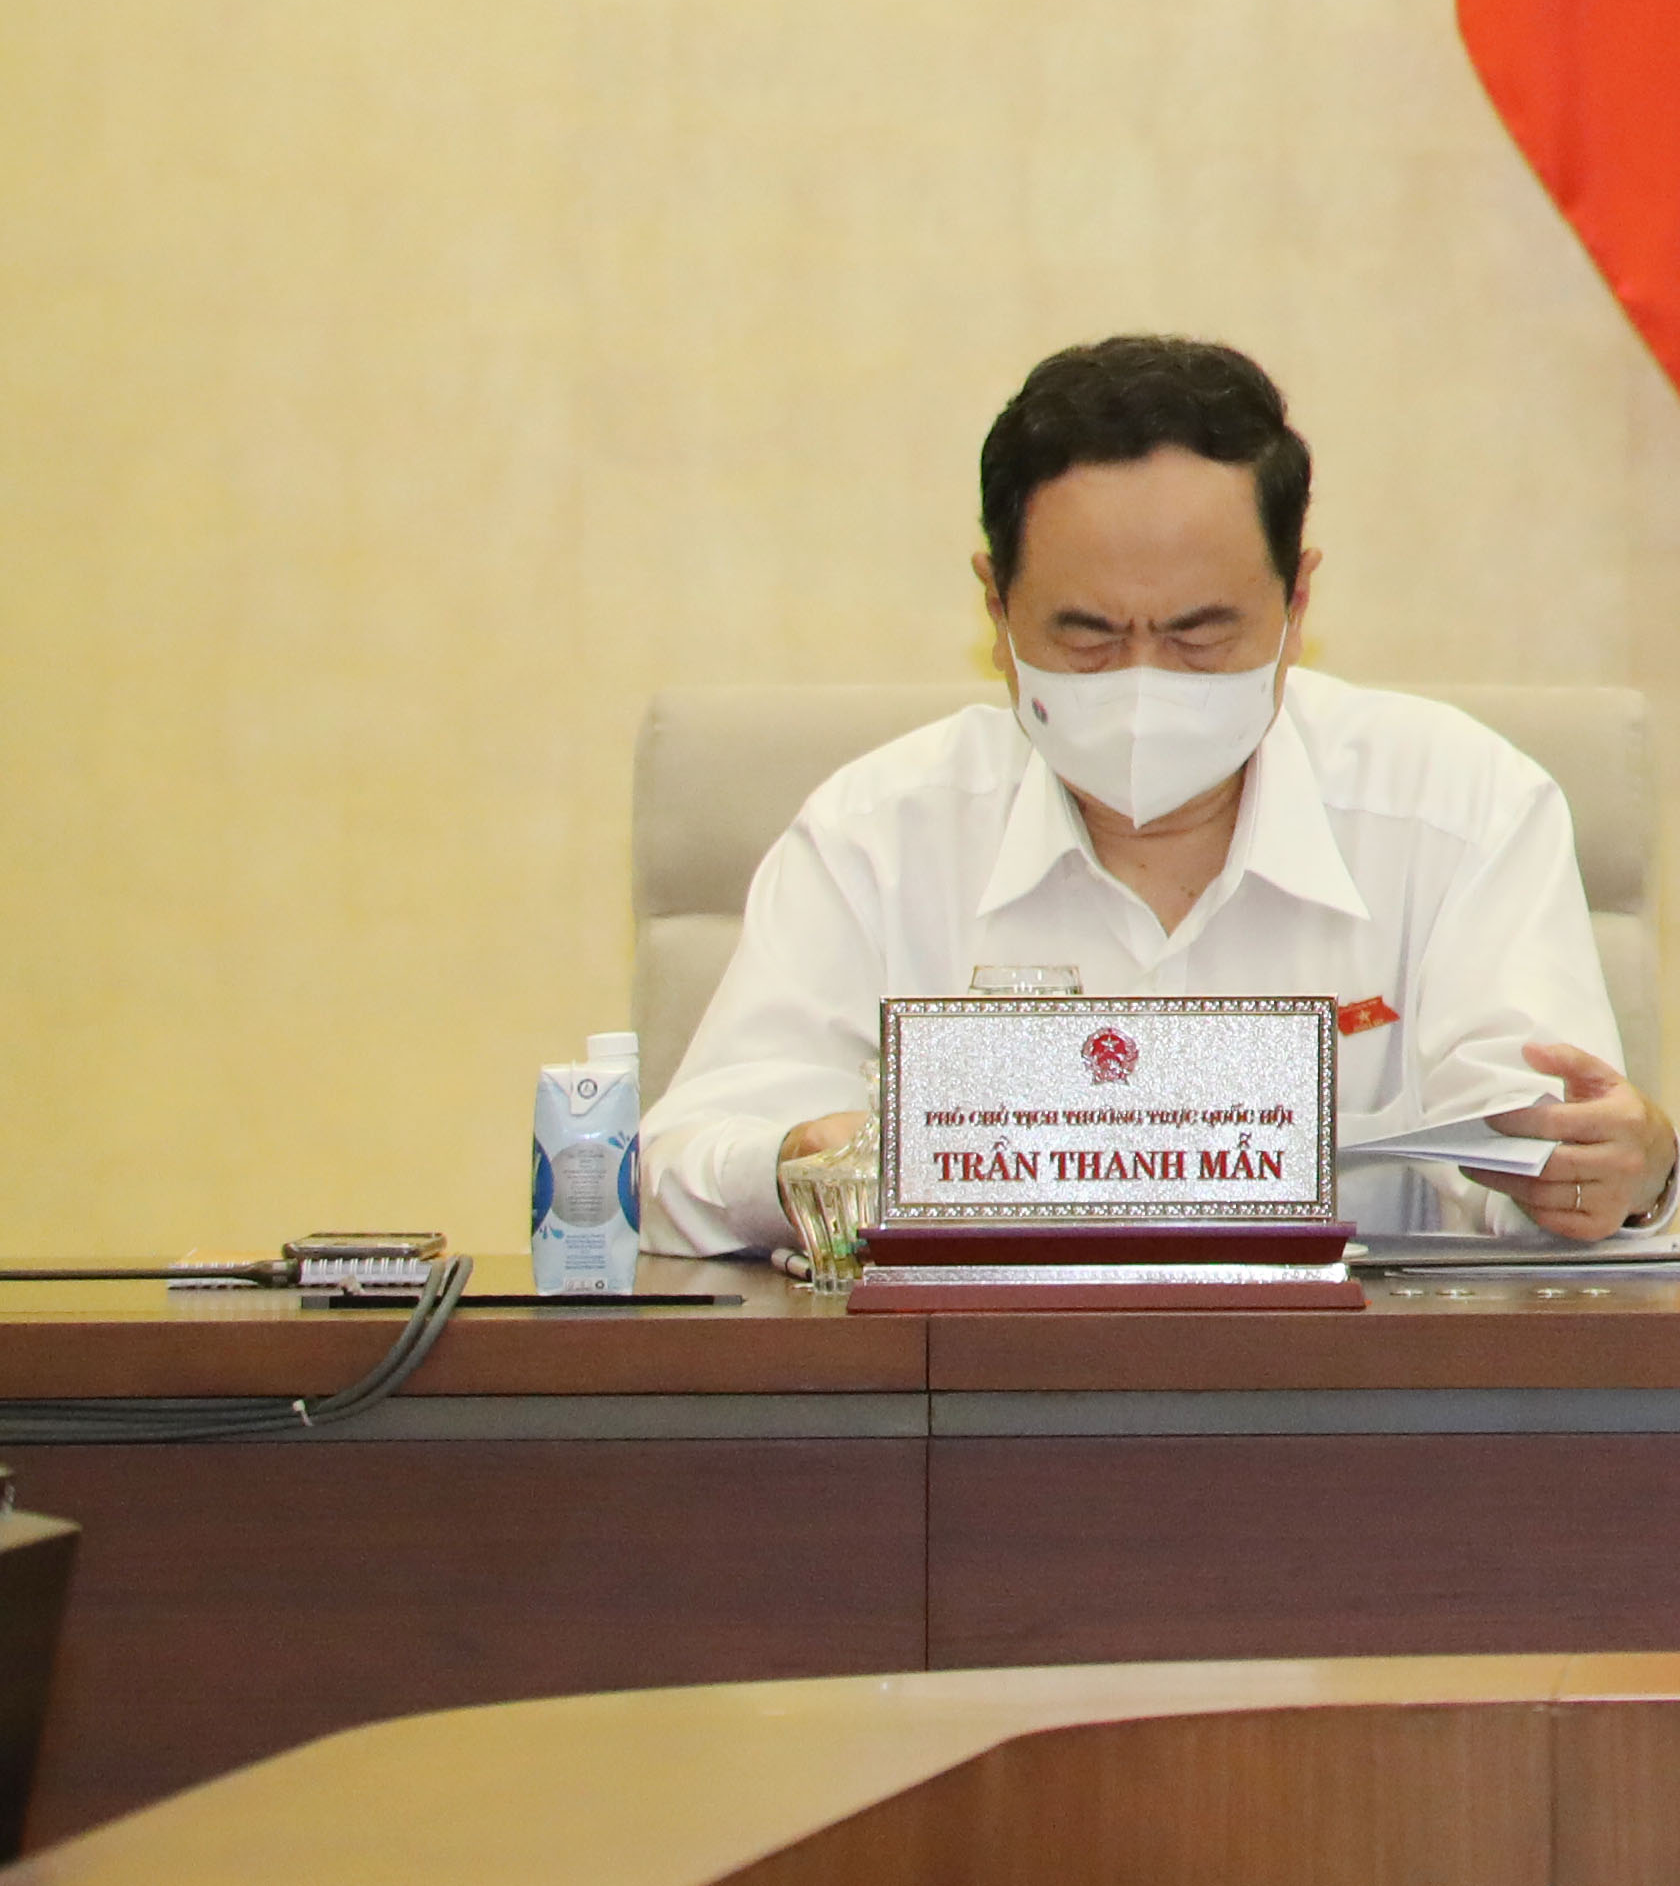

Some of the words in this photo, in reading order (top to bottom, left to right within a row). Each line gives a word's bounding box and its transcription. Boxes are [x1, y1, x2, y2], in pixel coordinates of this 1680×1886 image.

[925, 1106, 965, 1126] PHÓ
[969, 1103, 1009, 1126] CHỦ
[1013, 1110, 1058, 1130] TỊCH
[1201, 1102, 1254, 1128] QUỐC
[1258, 1104, 1294, 1128] HỘI
[933, 1134, 1041, 1182] TRẦN
[1050, 1149, 1187, 1181] THANH
[1198, 1132, 1285, 1181] MẪN
